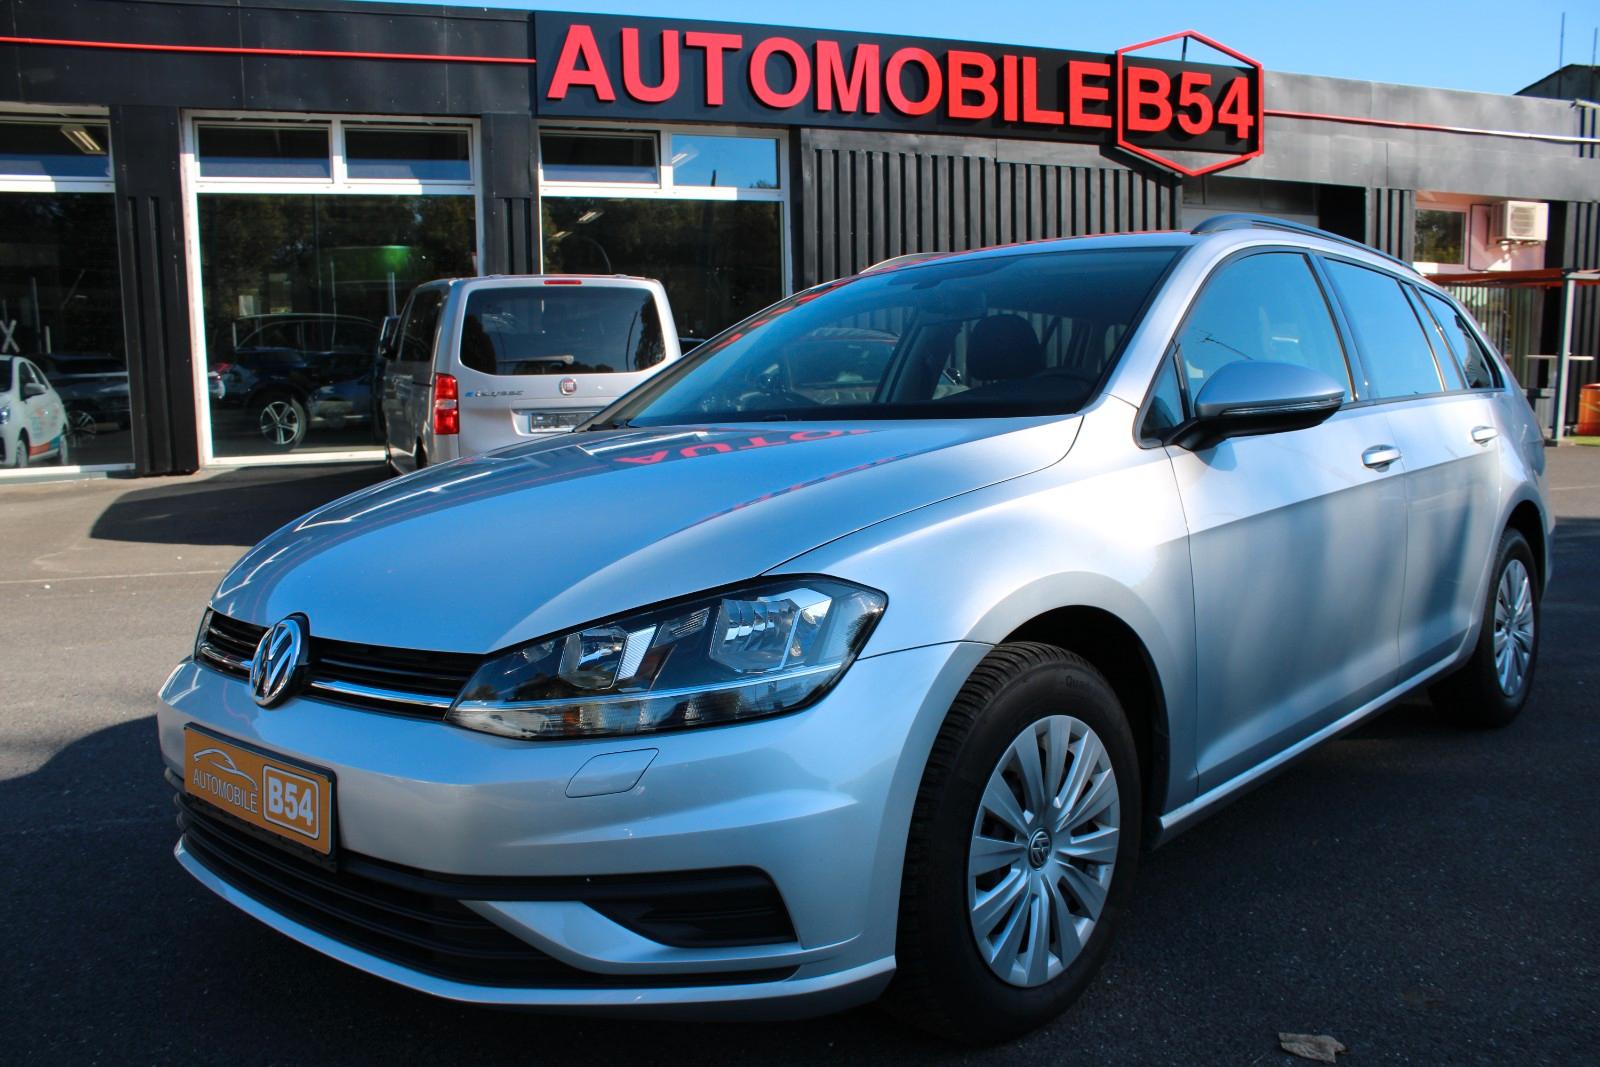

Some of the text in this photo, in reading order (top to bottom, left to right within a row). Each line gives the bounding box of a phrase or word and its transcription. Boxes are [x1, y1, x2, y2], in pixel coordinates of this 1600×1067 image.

[547, 23, 1254, 139] AUTOMOBILE B54
[193, 768, 313, 827] AUTOMOBILE B54
